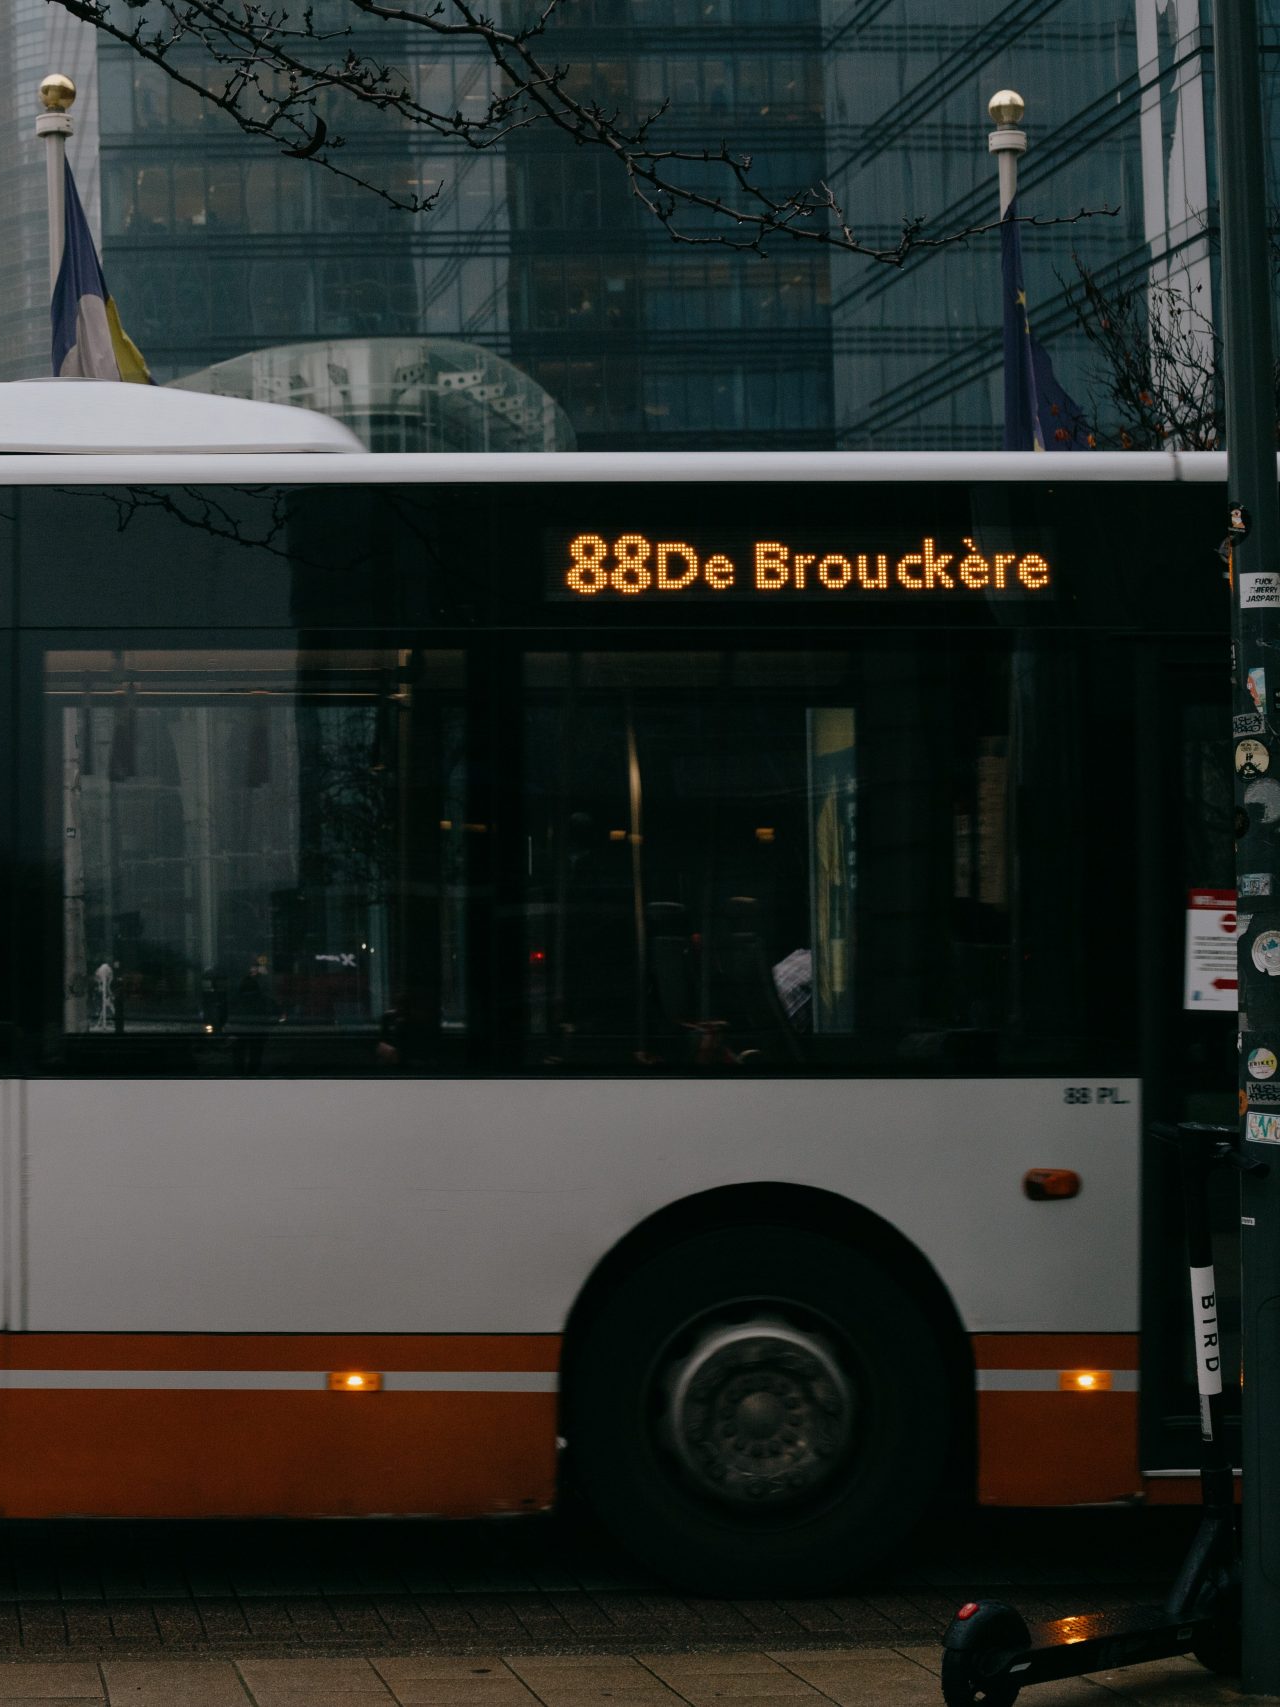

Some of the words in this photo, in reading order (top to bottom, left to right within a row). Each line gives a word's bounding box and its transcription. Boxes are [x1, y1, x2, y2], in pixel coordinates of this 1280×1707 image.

[566, 535, 651, 594] 88
[656, 542, 734, 588] De
[755, 537, 1049, 589] Brouckère
[1254, 577, 1273, 585] FUCK
[1064, 1087, 1092, 1104] 88
[1096, 1087, 1131, 1104] PL
[1201, 1293, 1219, 1373] BIRD
